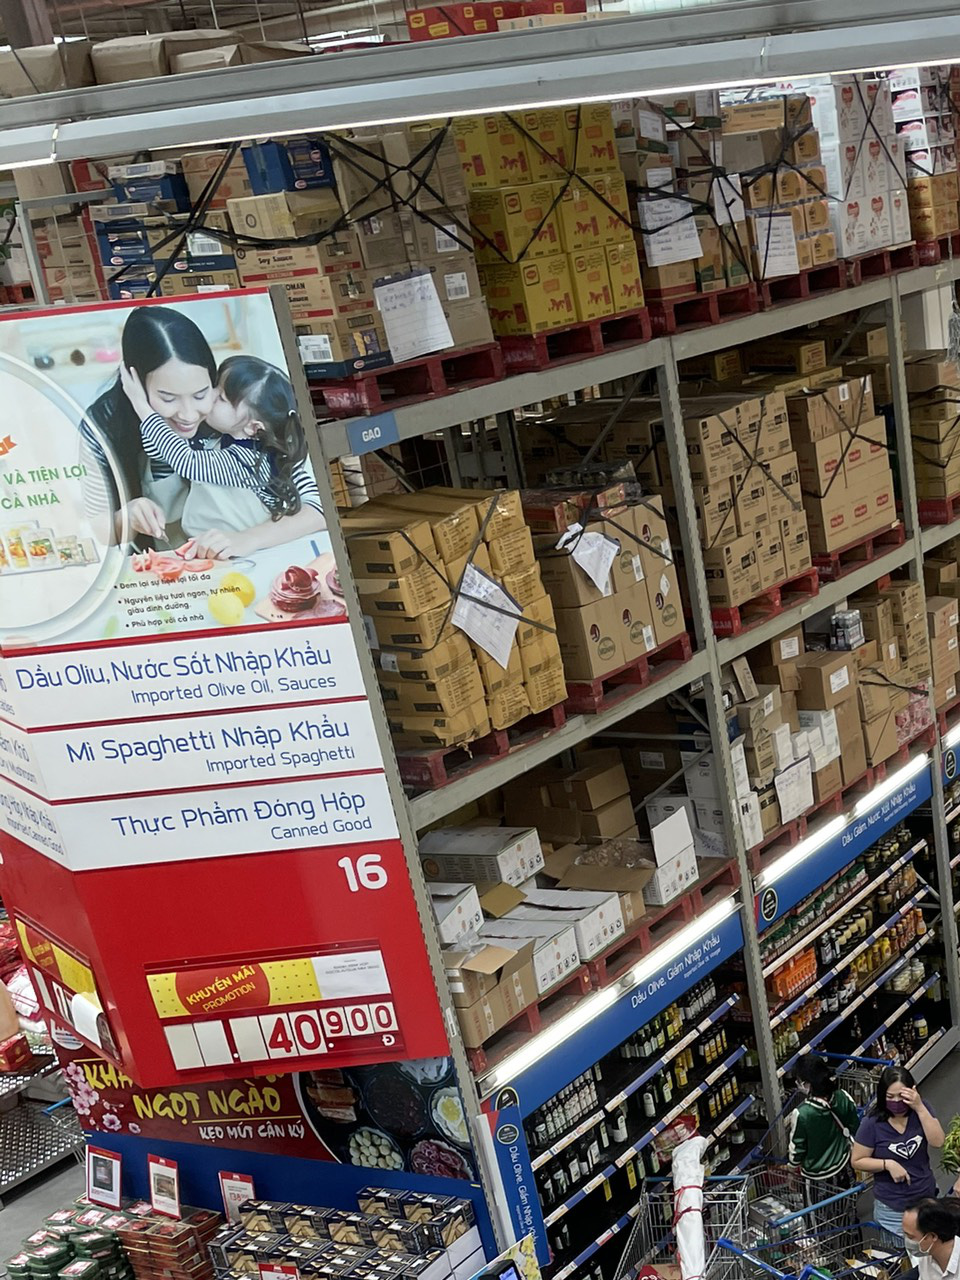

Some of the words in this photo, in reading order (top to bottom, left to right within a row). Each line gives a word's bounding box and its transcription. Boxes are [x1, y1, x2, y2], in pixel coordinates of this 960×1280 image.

[3, 468, 26, 485] VÀ
[28, 466, 60, 485] TIỆN
[65, 464, 88, 481] LỢI
[27, 489, 61, 507] NHÀ
[16, 663, 62, 690] Dầu
[65, 657, 111, 687] Oliu,
[112, 657, 170, 684] Nước
[173, 648, 214, 678] Sốt
[216, 649, 272, 680] Nhập
[276, 641, 332, 668] Khẩu
[131, 686, 203, 706] Imported
[207, 681, 246, 699] Olive
[251, 678, 272, 696] Oil,
[278, 675, 337, 693] Sauces
[66, 737, 95, 763] Mì
[101, 730, 216, 763] Spaghetti
[222, 724, 282, 753] Nhập
[289, 714, 349, 741] Khẩu
[206, 752, 277, 775] Imported
[280, 745, 356, 769] Spaghetti
[112, 812, 176, 839] Thực
[181, 801, 248, 830] Phẩm
[254, 796, 316, 826] Đóng
[321, 789, 366, 816] Hộp
[270, 820, 328, 841] Canned
[333, 815, 373, 836] Good
[338, 852, 388, 893] 16
[185, 975, 232, 1006] KHUYẾN
[233, 964, 256, 983] MÃI
[202, 981, 256, 1012] PROMOTION
[132, 1092, 201, 1122] NGỌT
[210, 1080, 281, 1114] NGÀO
[257, 1121, 286, 1140] CÂN
